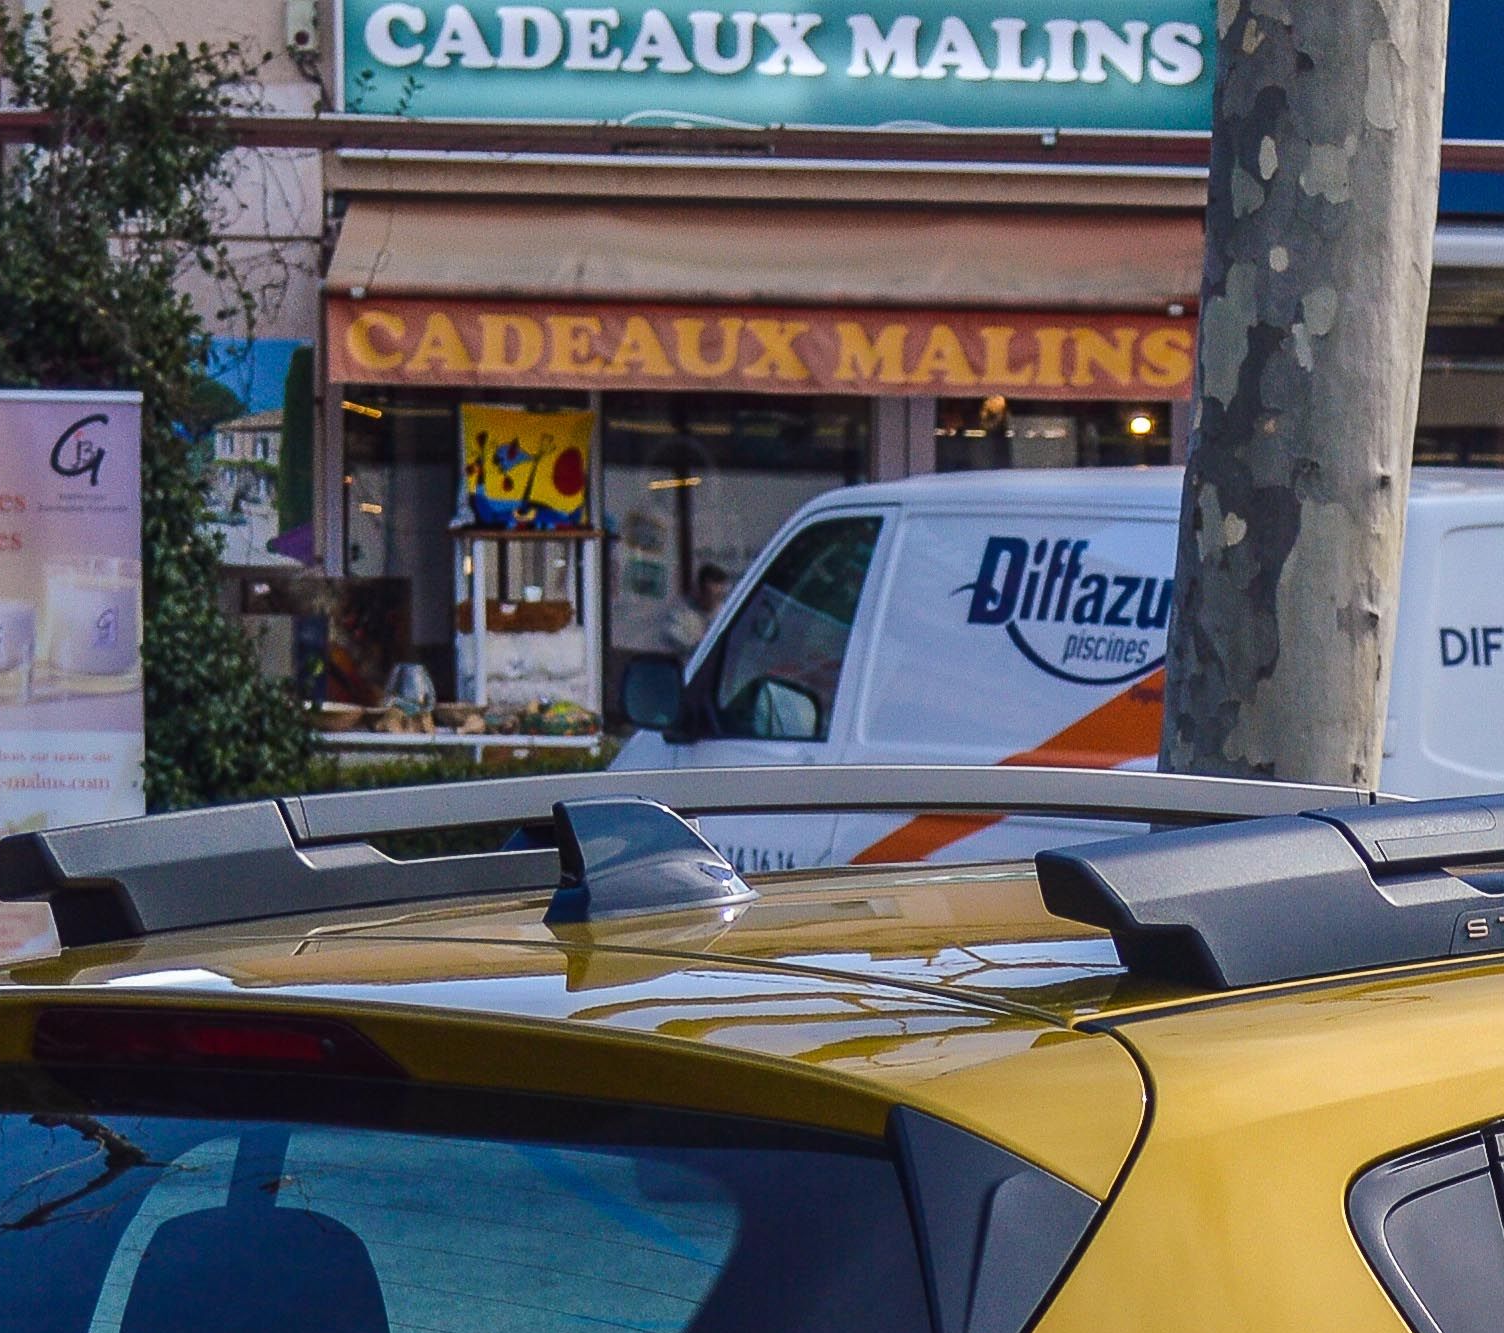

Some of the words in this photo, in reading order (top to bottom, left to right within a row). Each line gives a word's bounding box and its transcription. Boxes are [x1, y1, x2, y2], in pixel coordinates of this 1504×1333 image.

[365, 2, 827, 77] CADEAUX
[847, 16, 1205, 87] MALINS
[347, 310, 810, 381] CADEAUX
[833, 320, 1194, 389] MALINS
[967, 535, 1176, 630] Diffazu
[1061, 631, 1151, 665] piscines
